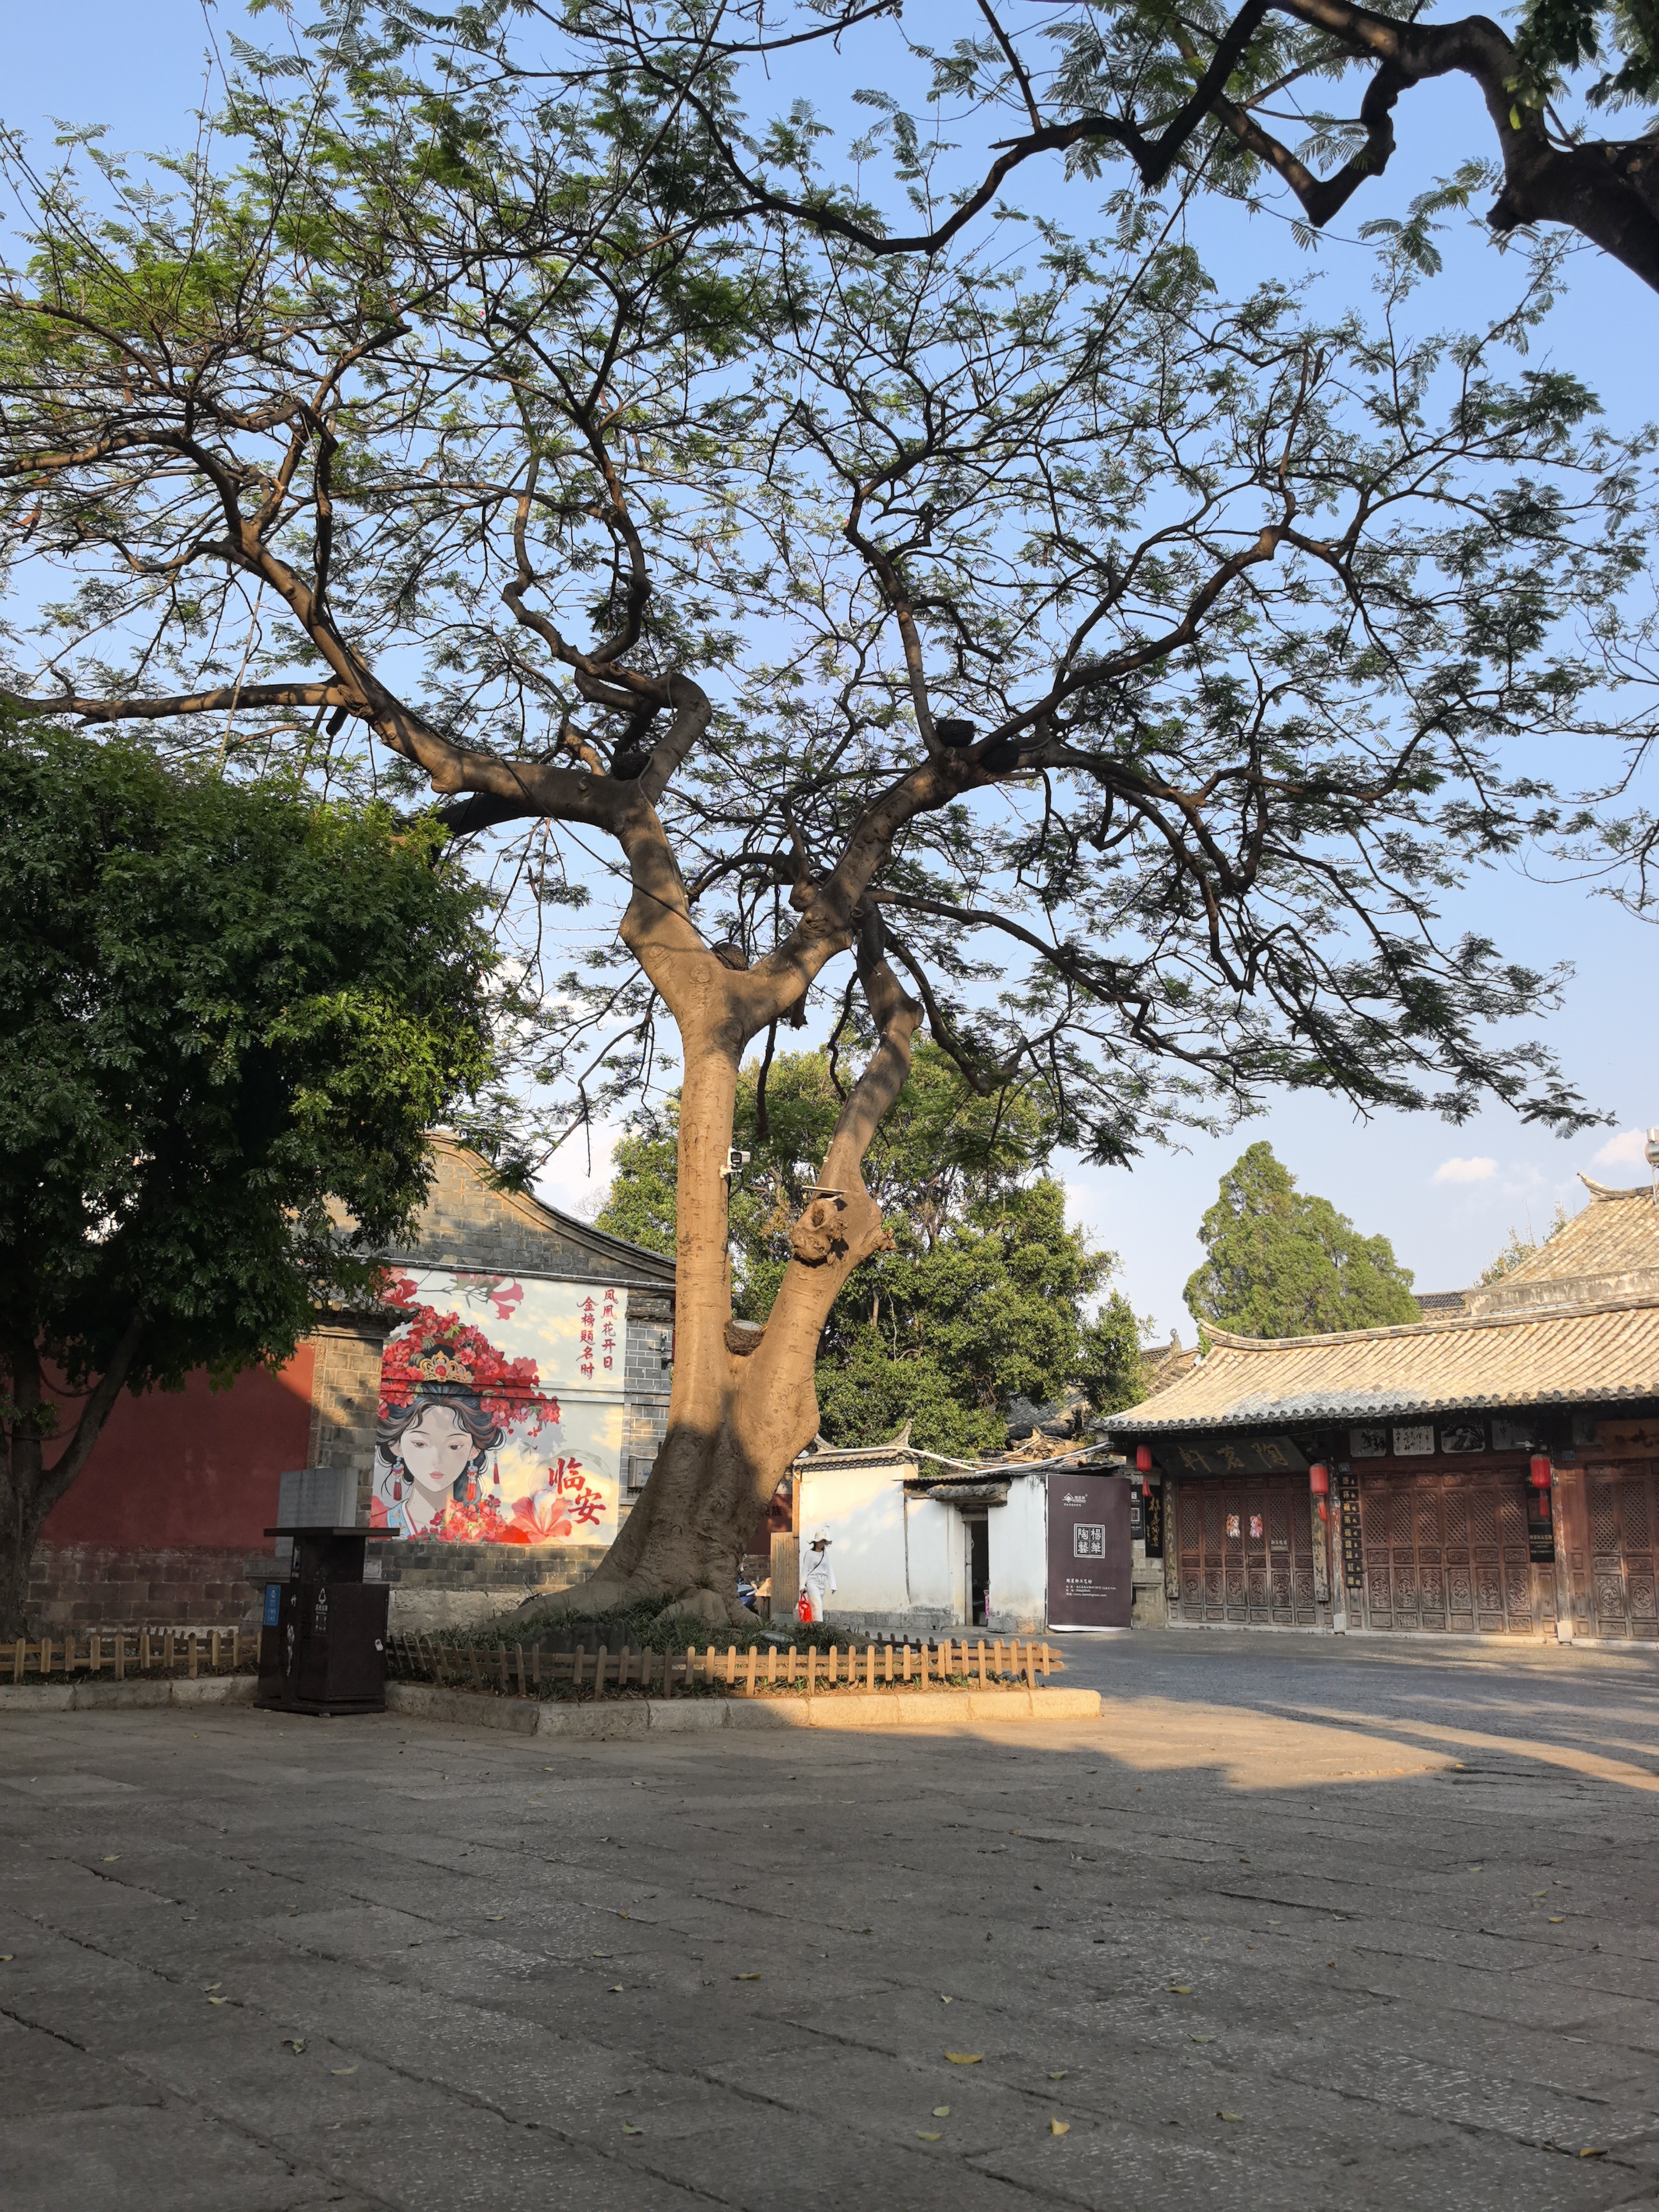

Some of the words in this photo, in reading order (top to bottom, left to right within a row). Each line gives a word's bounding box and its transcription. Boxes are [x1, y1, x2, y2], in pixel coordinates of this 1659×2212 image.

[576, 1296, 599, 1380] 金榜题名时
[601, 1289, 619, 1371] 凤凰花开日
[548, 1457, 606, 1525] 临安
